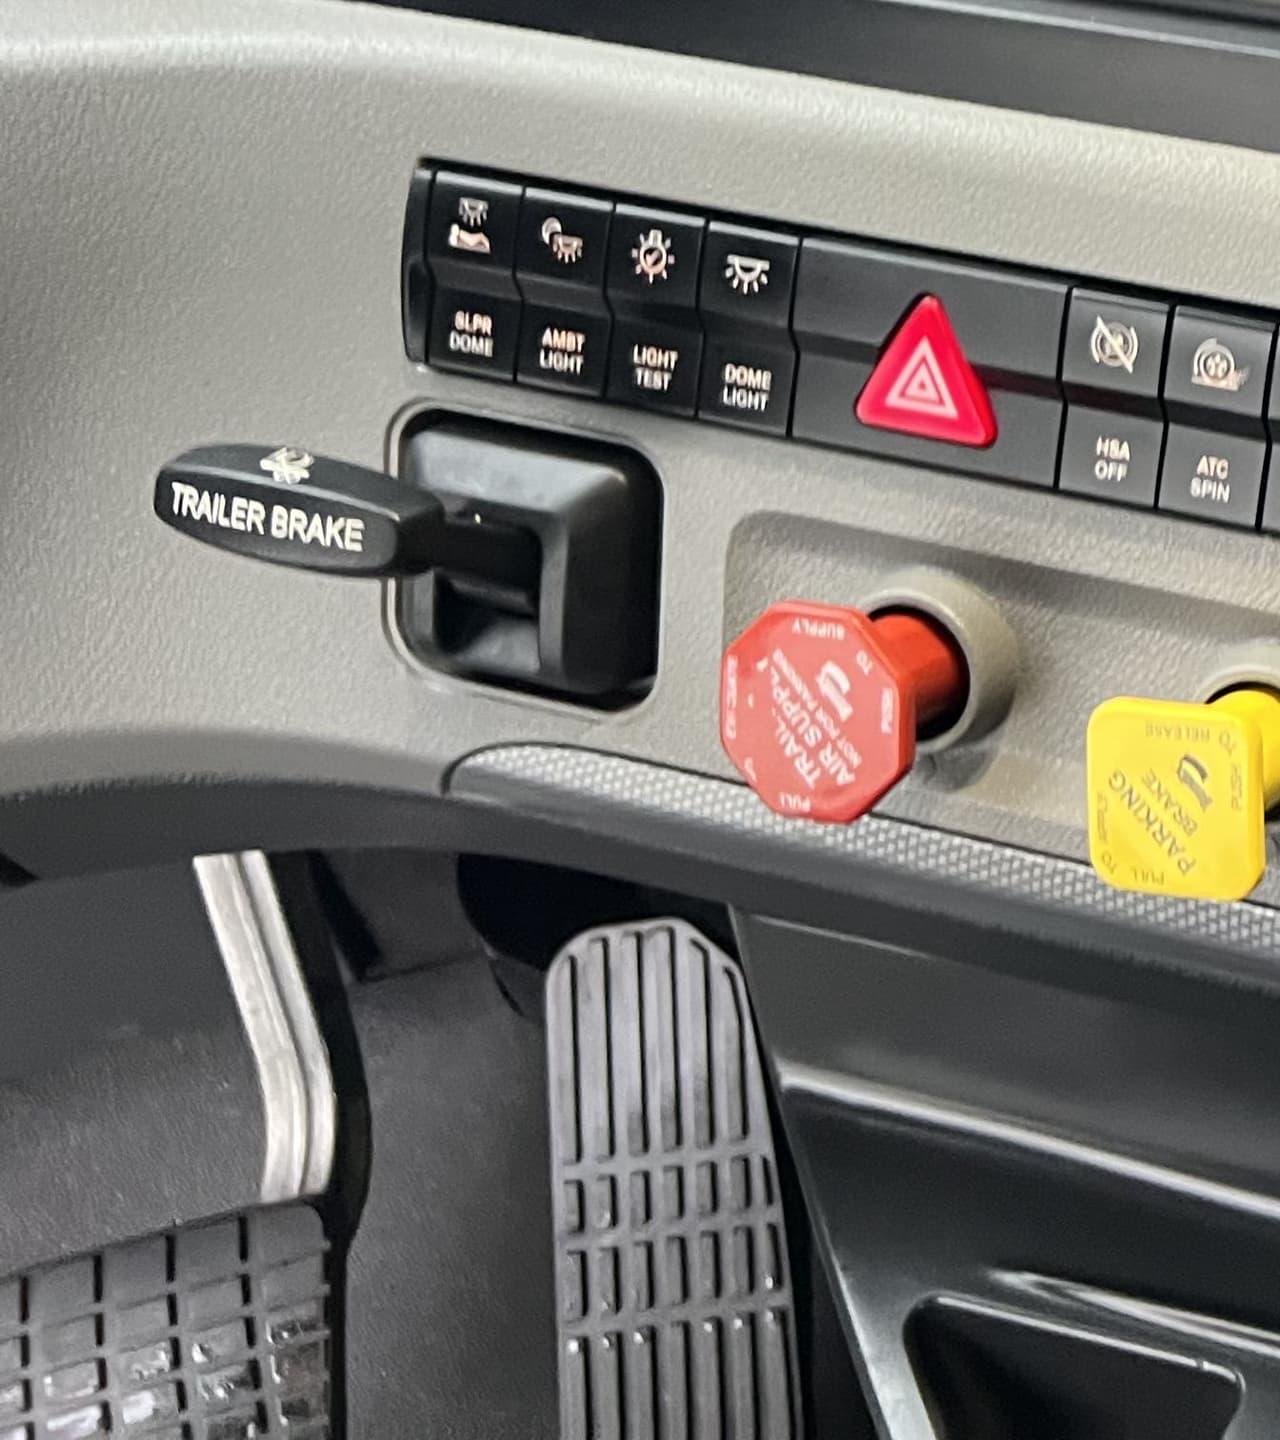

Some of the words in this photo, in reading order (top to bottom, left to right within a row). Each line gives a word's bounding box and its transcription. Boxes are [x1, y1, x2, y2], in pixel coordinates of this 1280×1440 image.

[449, 330, 494, 358] DOME
[632, 343, 679, 372] LIGHT
[539, 347, 584, 376] LIGHT
[635, 366, 673, 392] TEST
[724, 362, 773, 391] DOME
[722, 384, 770, 412] LIGHT
[1094, 459, 1129, 483] OFF
[1189, 476, 1231, 504] SPIN
[170, 481, 267, 536] TRAILER
[270, 506, 366, 553] BRAKE
[791, 617, 846, 641] SUPPLY
[772, 706, 822, 789] TRAIL
[817, 744, 856, 786] AIR
[1141, 766, 1199, 837] BRAKE
[1108, 769, 1198, 876] PARKING
